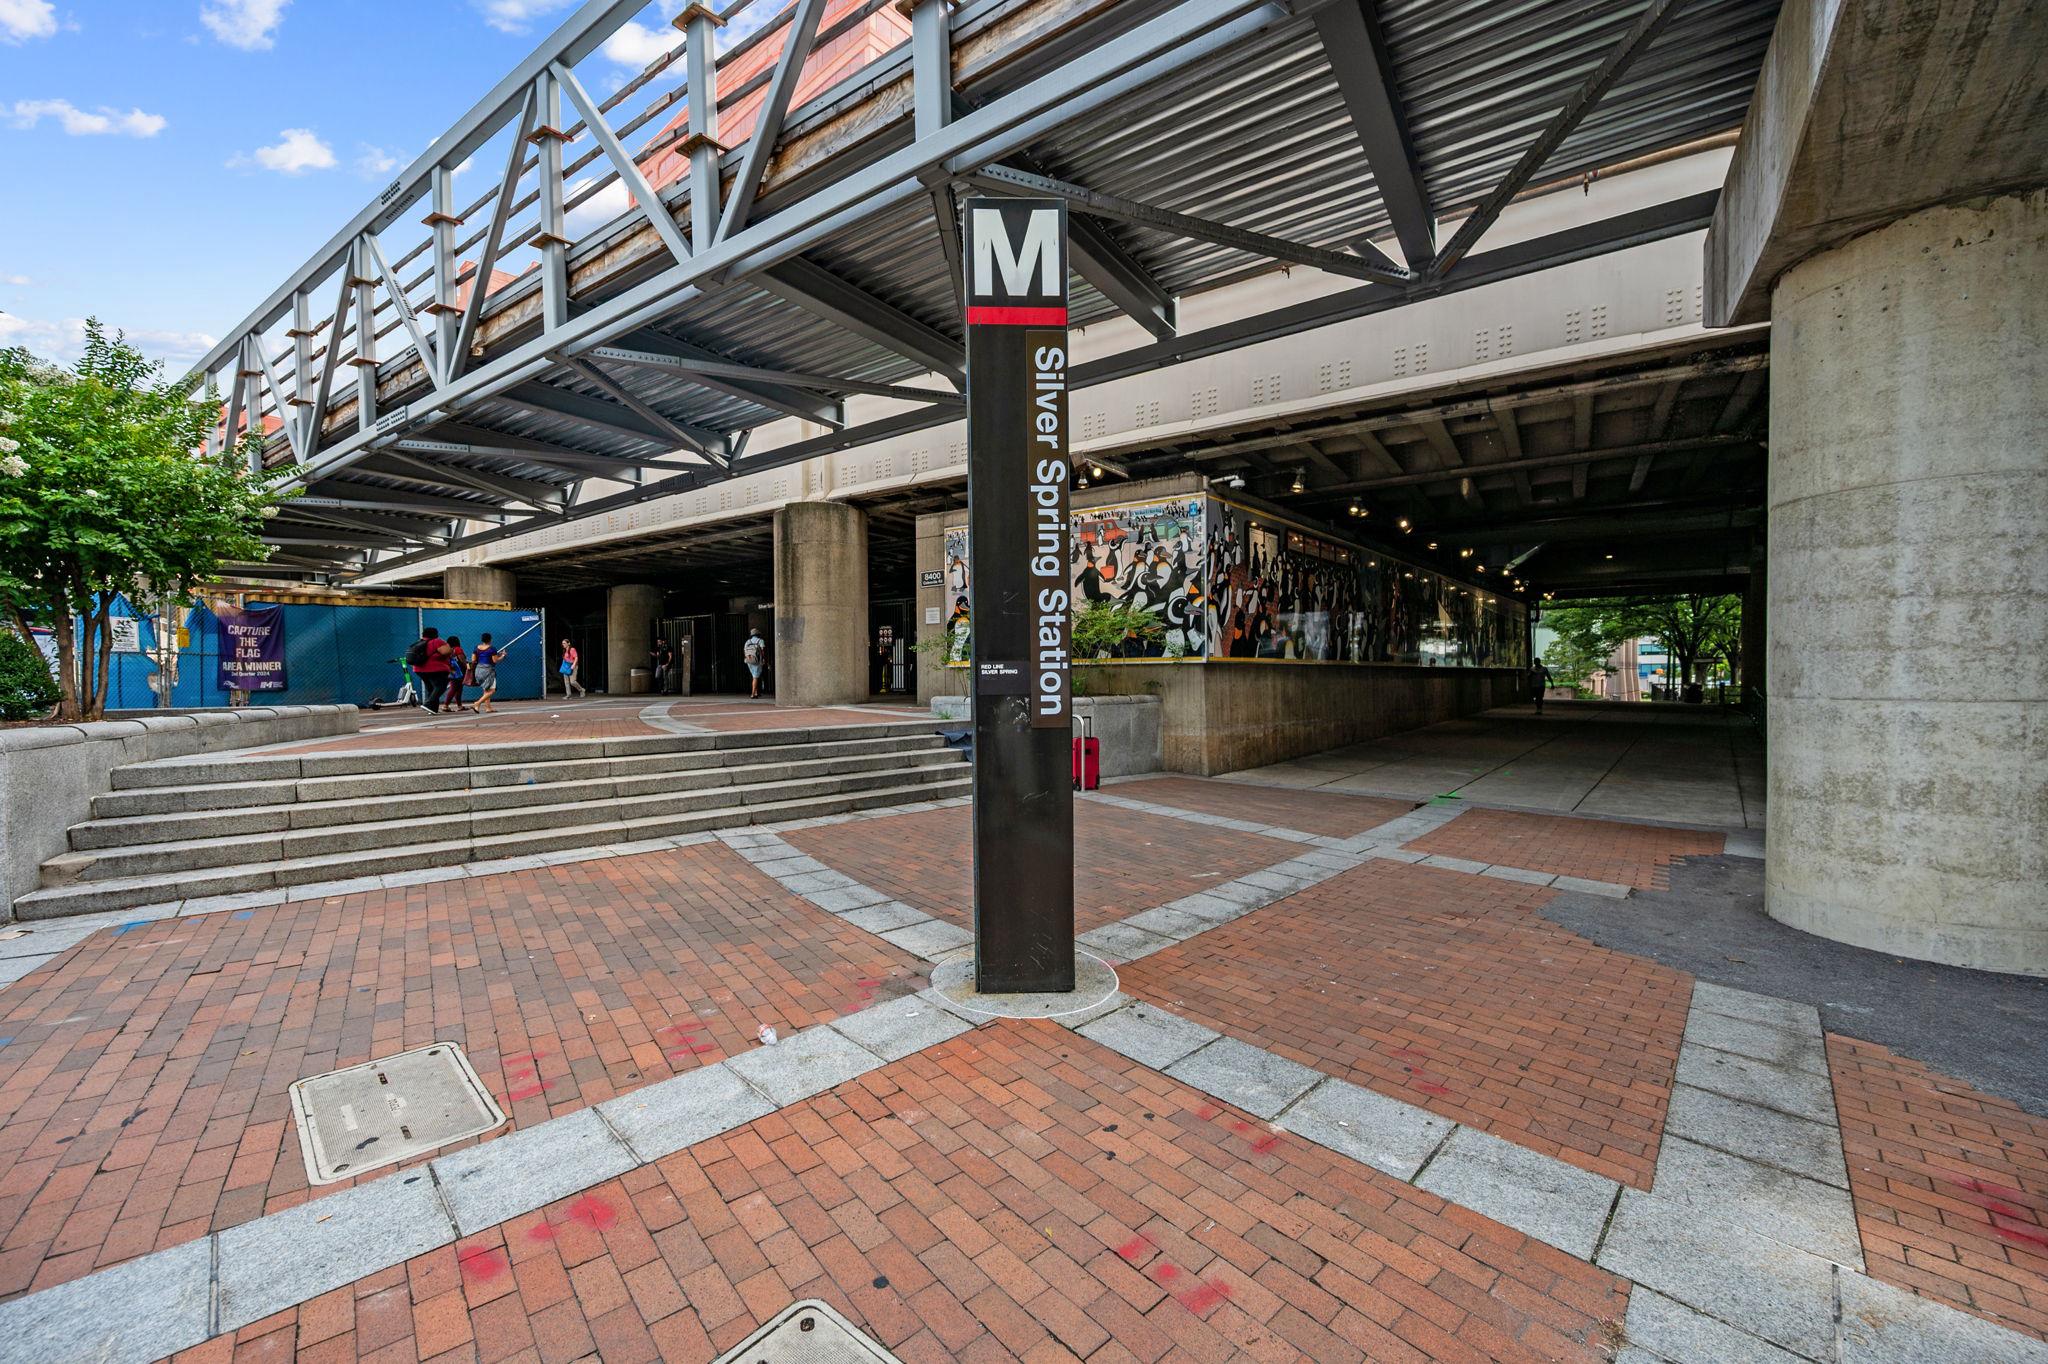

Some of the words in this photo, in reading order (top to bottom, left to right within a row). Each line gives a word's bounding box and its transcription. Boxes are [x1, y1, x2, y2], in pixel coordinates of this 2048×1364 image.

[973, 208, 1061, 297] M
[1034, 346, 1065, 449] Silver
[1030, 459, 1067, 577] Spring
[924, 572, 941, 581] 8400
[228, 625, 271, 636] CAPTURE
[240, 637, 258, 647] THE
[236, 648, 261, 658] FLAG
[1038, 588, 1069, 715] Station
[222, 662, 243, 671] AREA
[244, 662, 282, 671] WINNER
